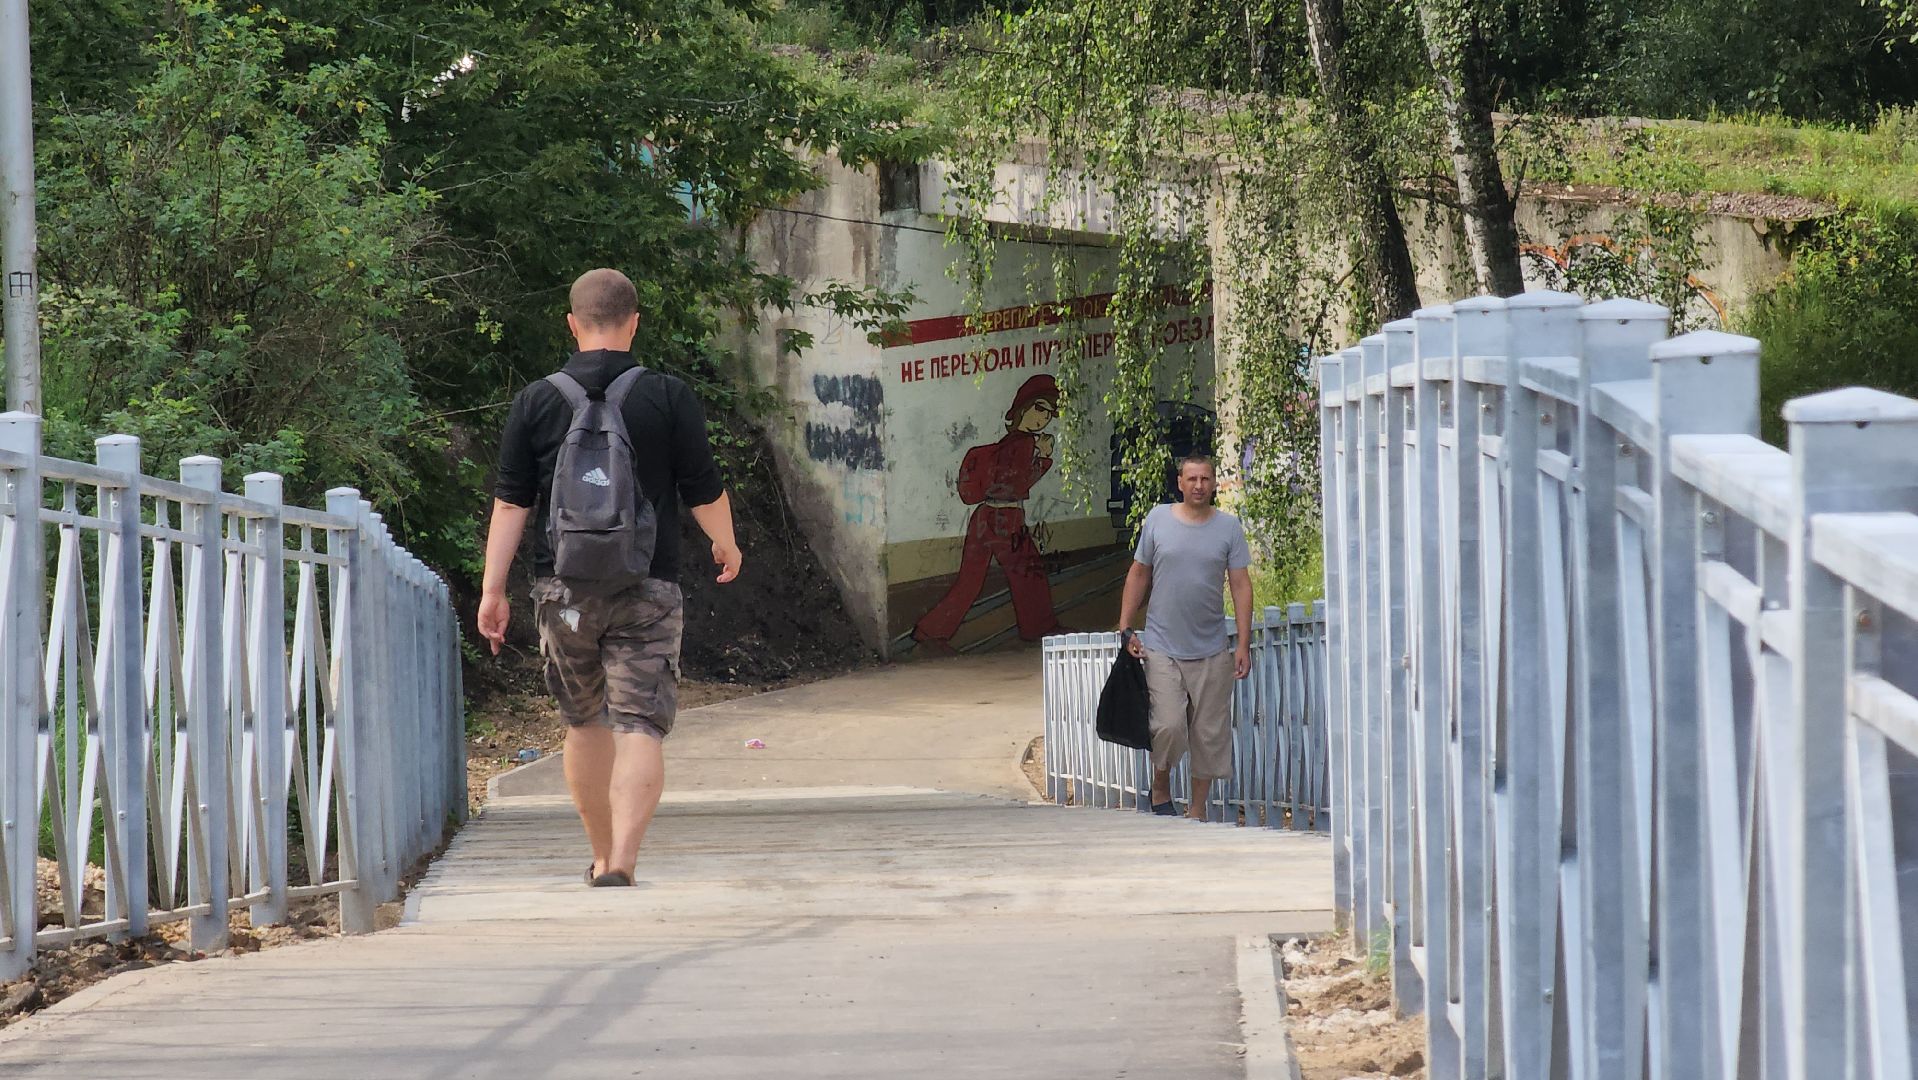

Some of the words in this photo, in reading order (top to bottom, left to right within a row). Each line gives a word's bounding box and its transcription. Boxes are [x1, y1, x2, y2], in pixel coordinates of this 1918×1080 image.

[976, 304, 1053, 333] ЕРЕГИТЕ
[901, 359, 925, 383] НЕ
[930, 343, 1025, 379] ПЕРЕХОДИ
[1032, 336, 1078, 366] ПУТ
[582, 475, 610, 487] adidas
